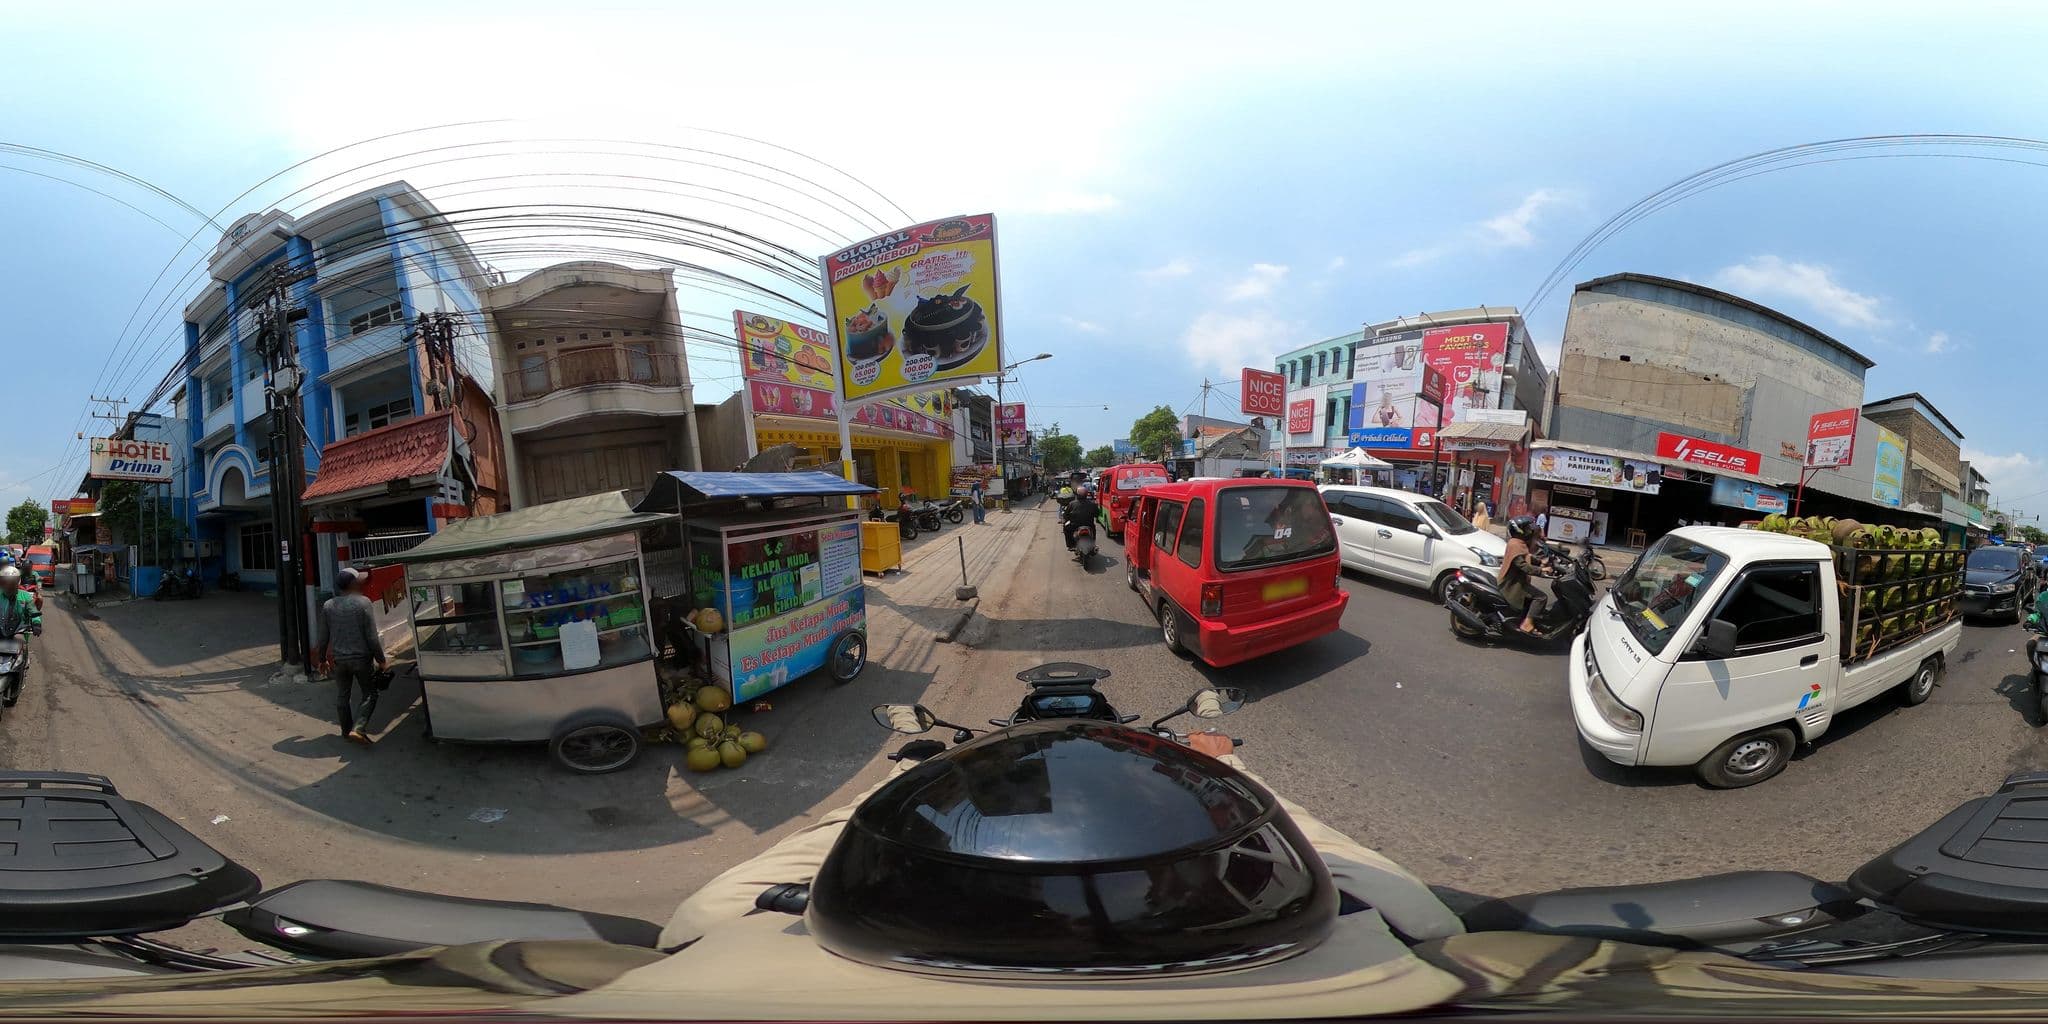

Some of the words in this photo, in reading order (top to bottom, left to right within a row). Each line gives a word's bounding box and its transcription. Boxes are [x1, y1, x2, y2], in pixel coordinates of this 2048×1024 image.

[837, 231, 910, 263] GLOBAL
[836, 259, 873, 279] PROMO
[875, 244, 918, 265] HEBOH
[1372, 334, 1402, 345] SAMSUNG
[1444, 335, 1472, 344] MOST
[904, 362, 934, 374] 100.000
[1249, 379, 1282, 396] NICE
[1291, 406, 1309, 418] NICE
[108, 441, 172, 462] HOTEL
[109, 459, 162, 474] Prima
[1579, 457, 1605, 465] TELLER
[1722, 463, 1746, 473] FUTURE
[1273, 527, 1292, 539] 04
[763, 541, 785, 557] ES
[741, 561, 781, 580] KELAPA
[786, 552, 810, 569] MUDA
[766, 624, 788, 643] Jus
[789, 611, 824, 634] Kelapa
[826, 599, 849, 616] Muda
[741, 656, 759, 673] Es
[760, 641, 800, 665] Kelapa
[803, 628, 829, 646] Muda
